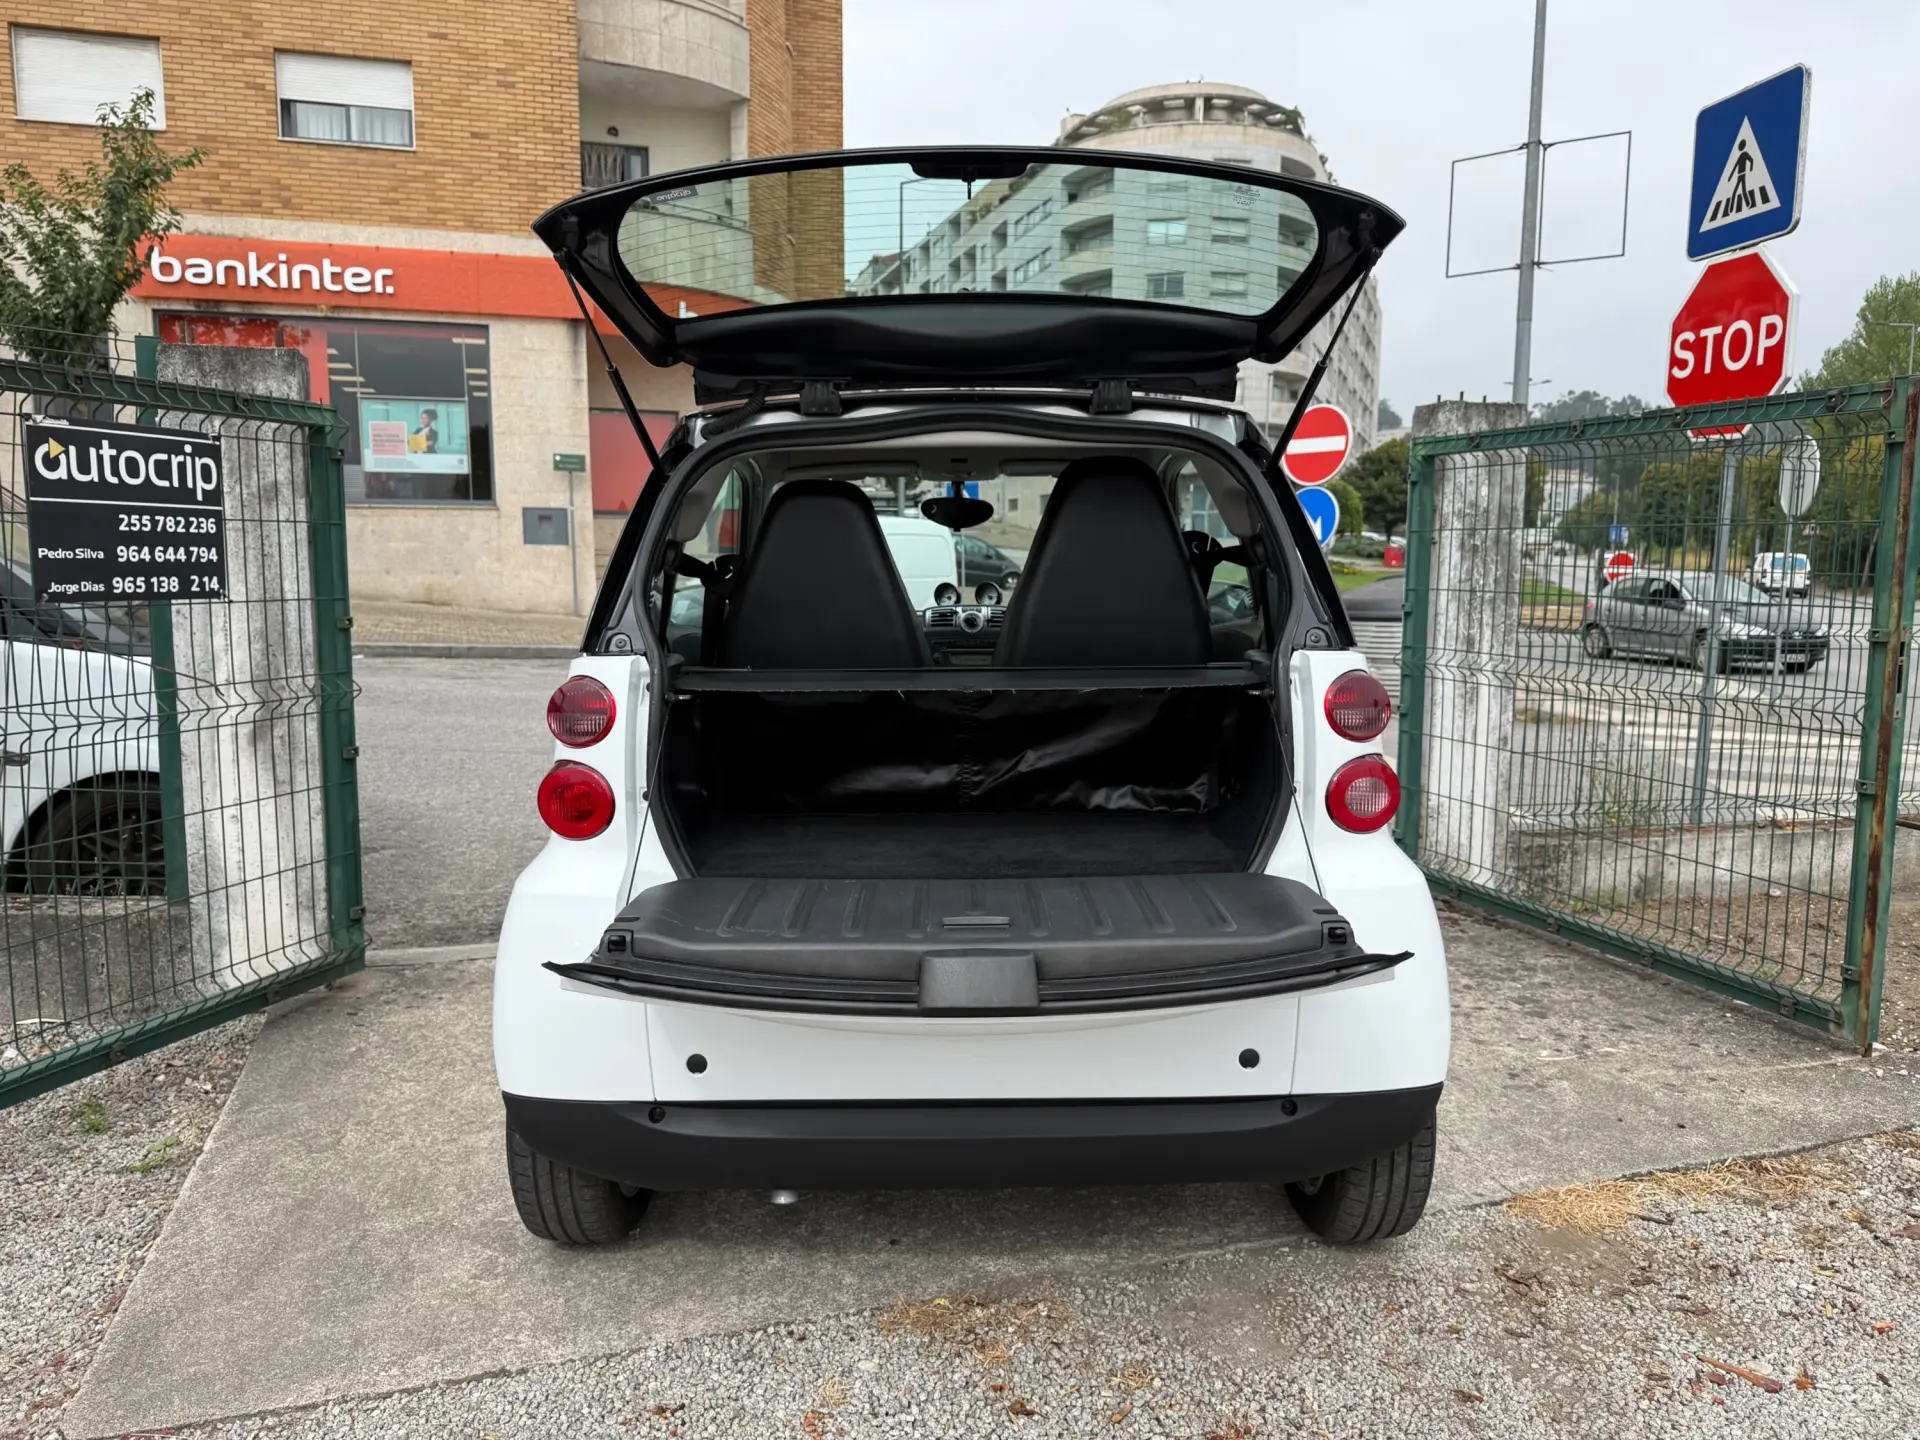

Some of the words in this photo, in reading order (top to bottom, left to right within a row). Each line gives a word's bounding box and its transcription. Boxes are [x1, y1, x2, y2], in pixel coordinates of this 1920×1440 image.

[1671, 314, 1784, 379] STOP
[34, 438, 218, 501] autocrip
[118, 514, 151, 532] 255
[154, 515, 186, 533] 782
[189, 517, 217, 534] 236
[37, 547, 74, 559] Pedro
[75, 548, 105, 559] Silva
[116, 545, 152, 562] 964
[154, 546, 187, 563] 644
[189, 546, 218, 563] 794
[47, 581, 80, 595] Jorge
[80, 581, 105, 592] Dias
[112, 576, 146, 593] 965
[150, 576, 179, 593] 138
[190, 575, 220, 592] 214
